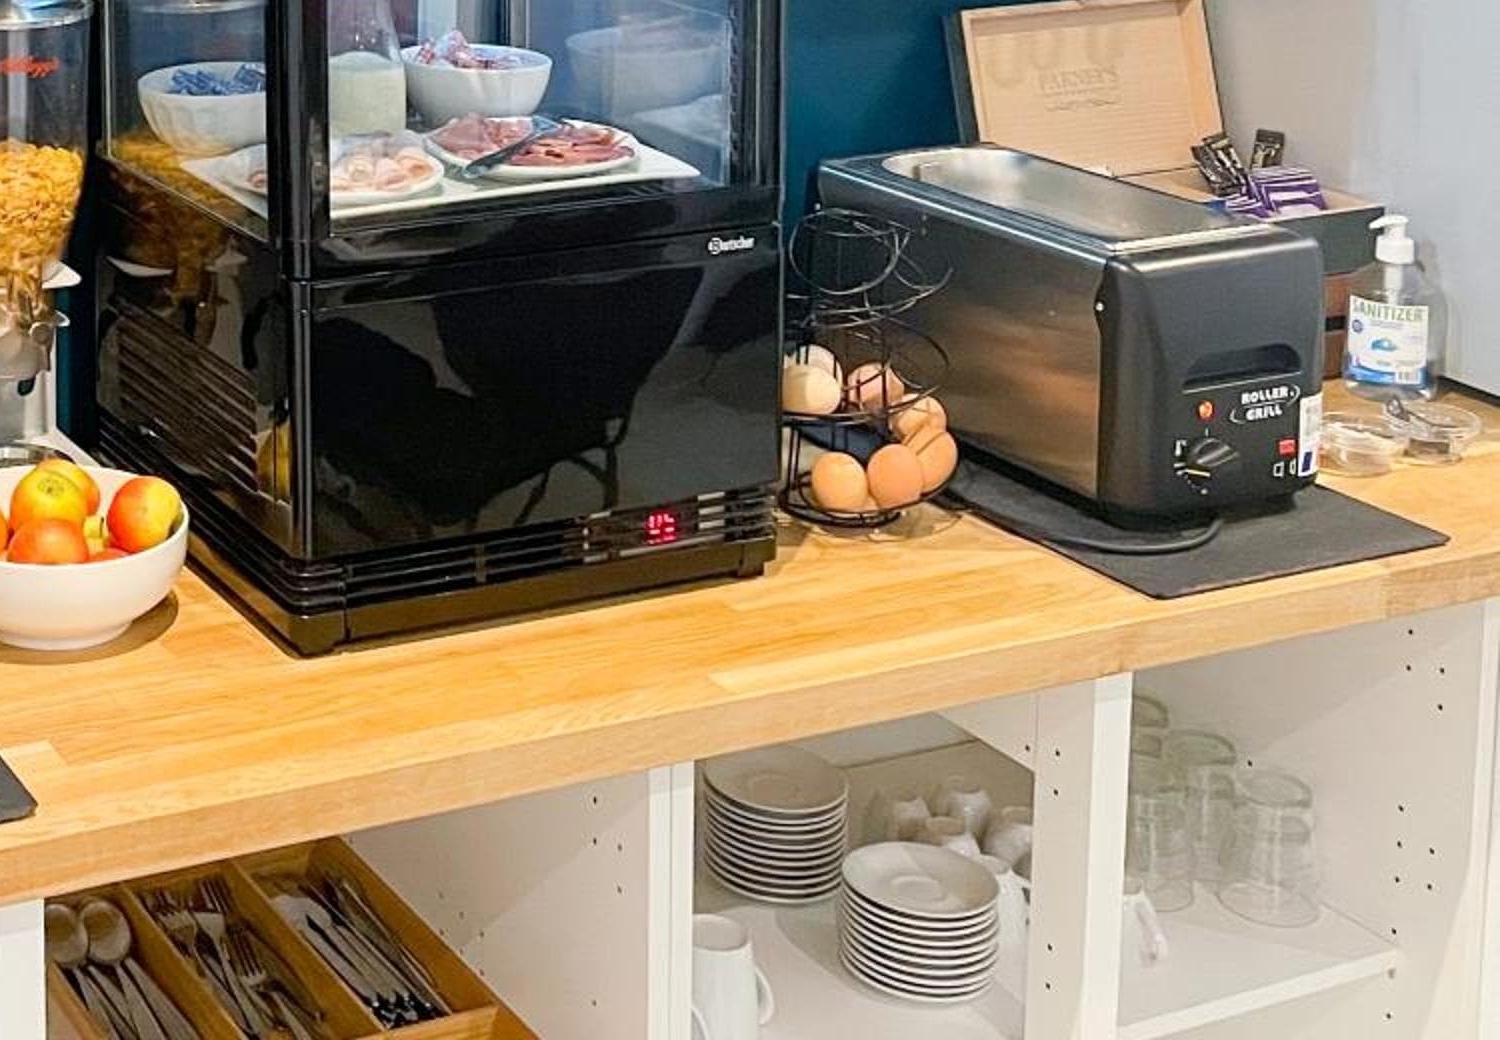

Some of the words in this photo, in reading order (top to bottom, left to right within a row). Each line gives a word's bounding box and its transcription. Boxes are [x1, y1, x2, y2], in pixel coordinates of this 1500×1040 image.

[1352, 298, 1423, 321] SANITIZER
[1241, 386, 1289, 405] ROLLER
[1245, 404, 1282, 421] GRILL
